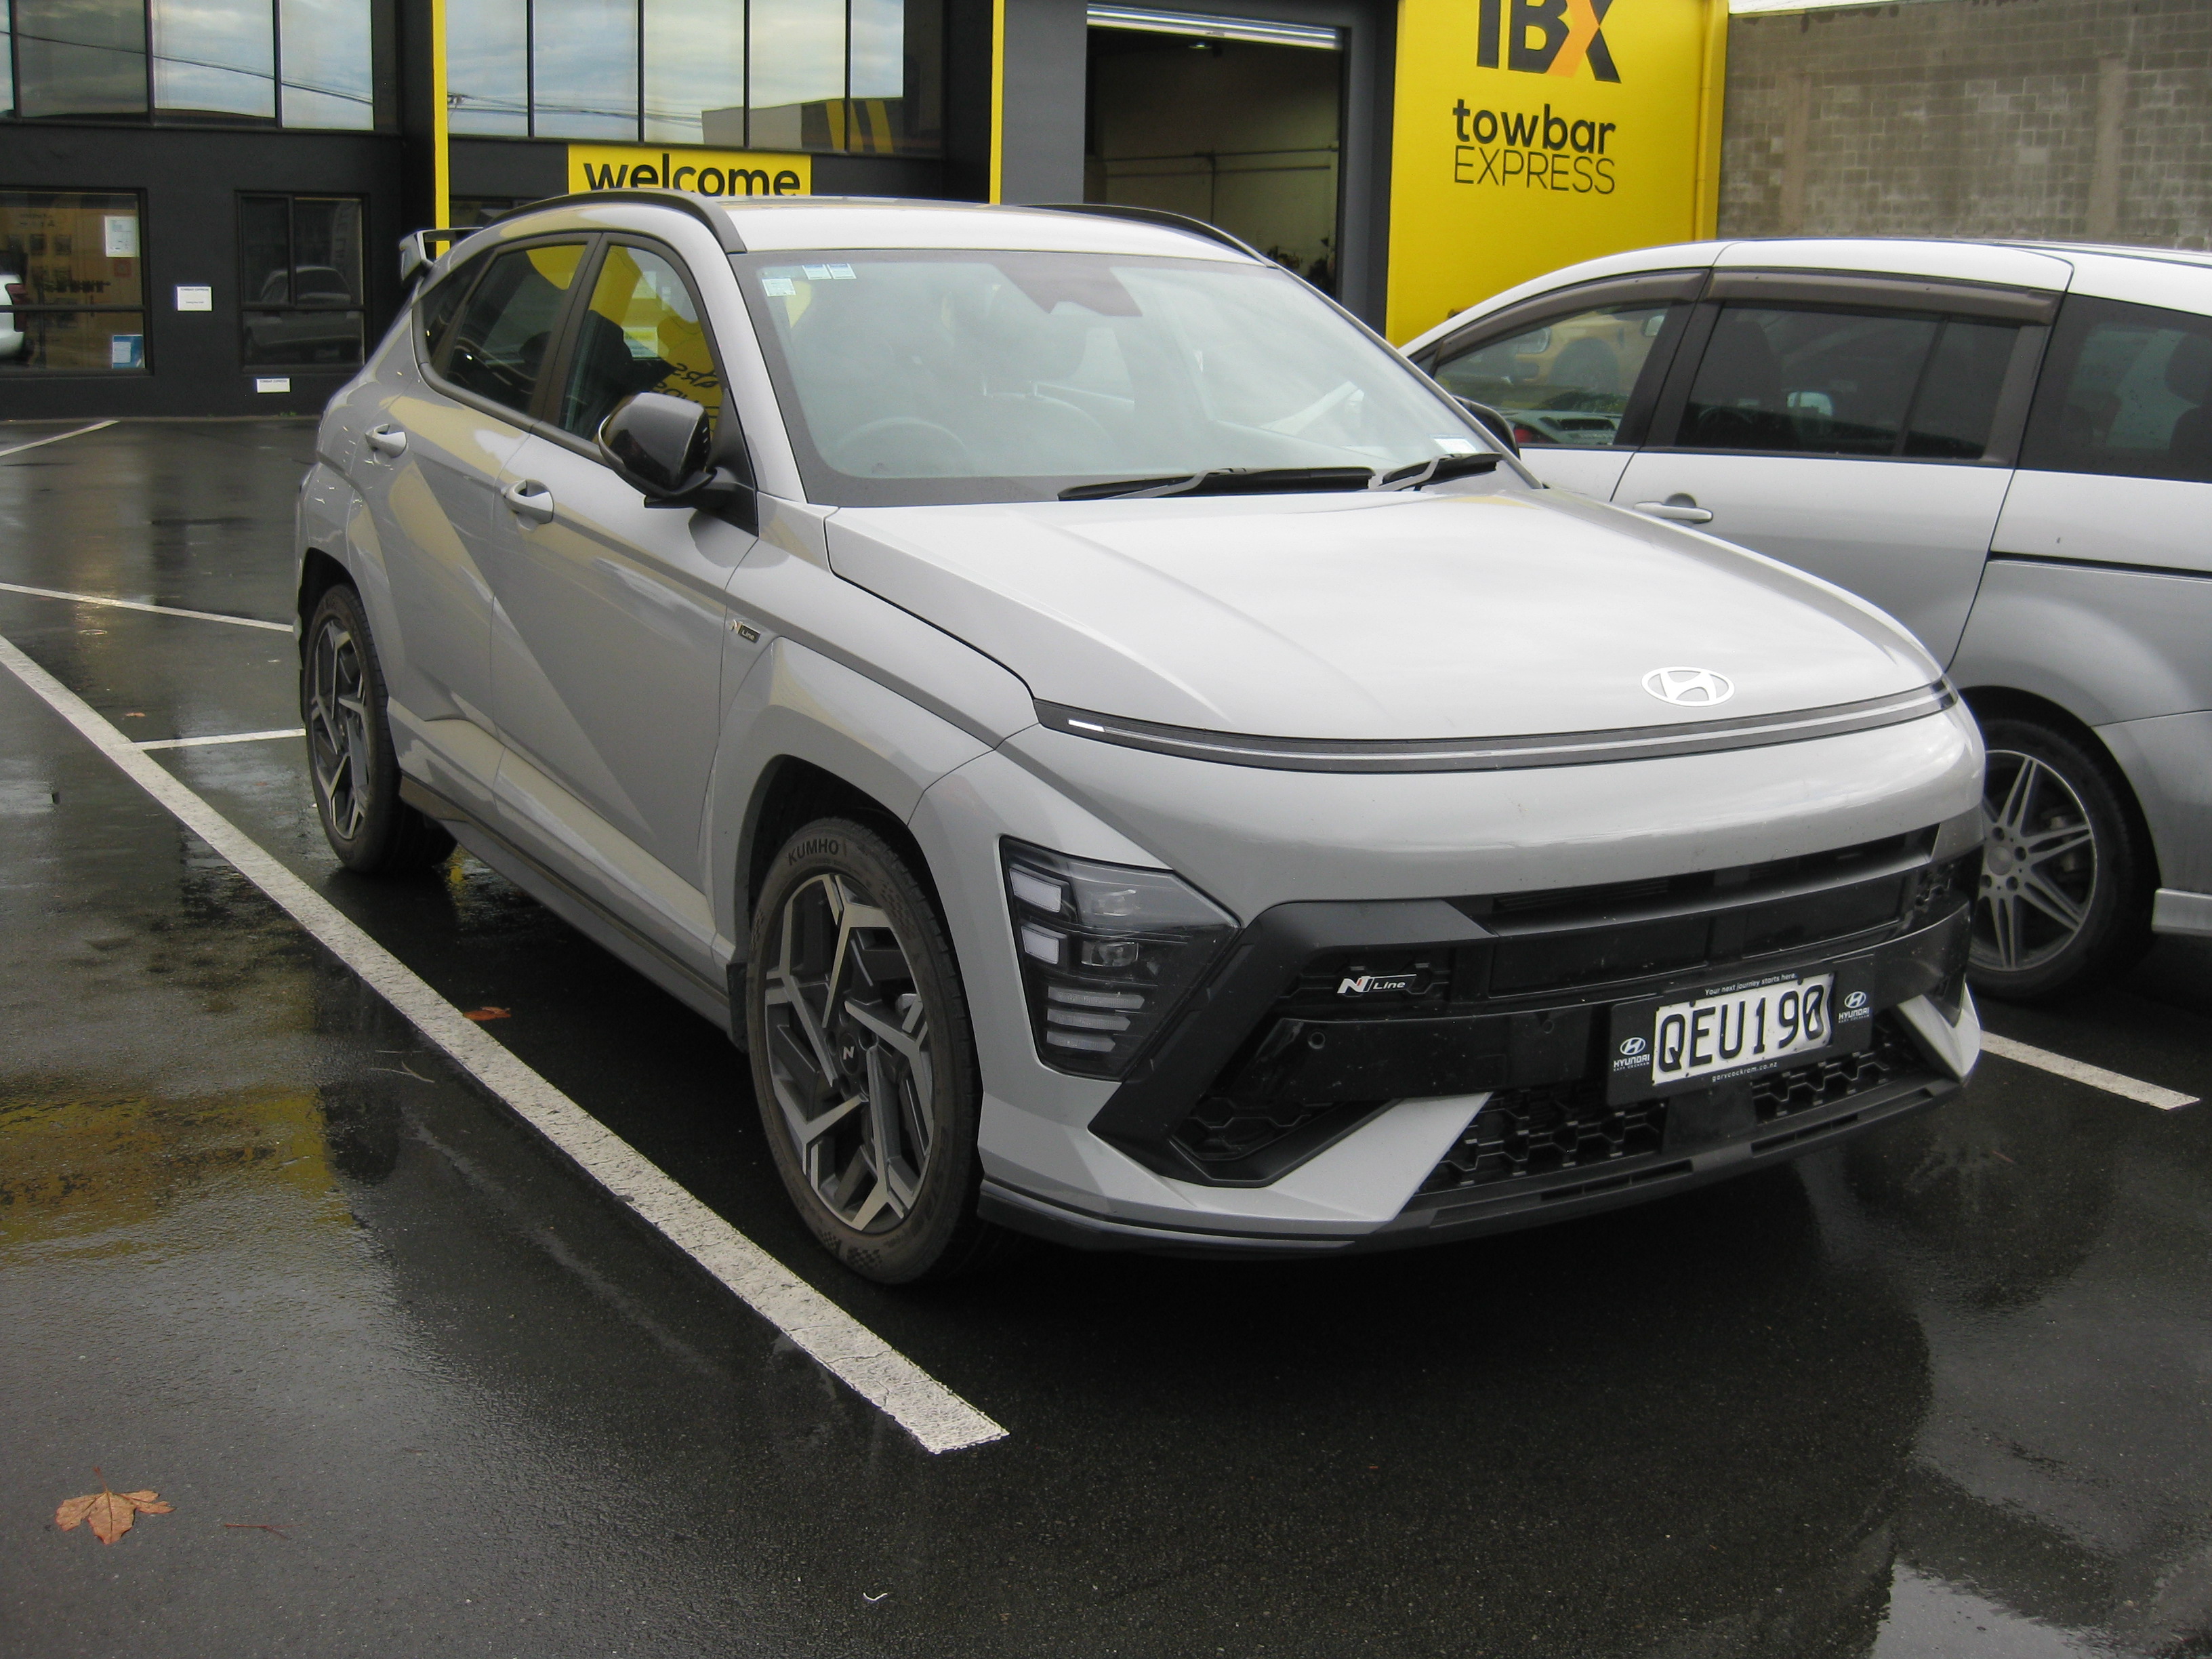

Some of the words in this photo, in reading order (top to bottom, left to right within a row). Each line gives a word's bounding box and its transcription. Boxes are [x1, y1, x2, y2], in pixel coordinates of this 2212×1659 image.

[1452, 98, 1616, 155] towbar
[583, 152, 801, 197] welcome
[1454, 144, 1615, 194] EXPRESS
[787, 838, 839, 865] KUMHO
[1721, 984, 1736, 992] next
[1736, 980, 1761, 991] journey
[1761, 976, 1780, 985] starts
[1658, 984, 1824, 1073] QEU190
[1838, 1007, 1870, 1020] HYUNDAI
[1614, 1054, 1650, 1068] HYUNDAI
